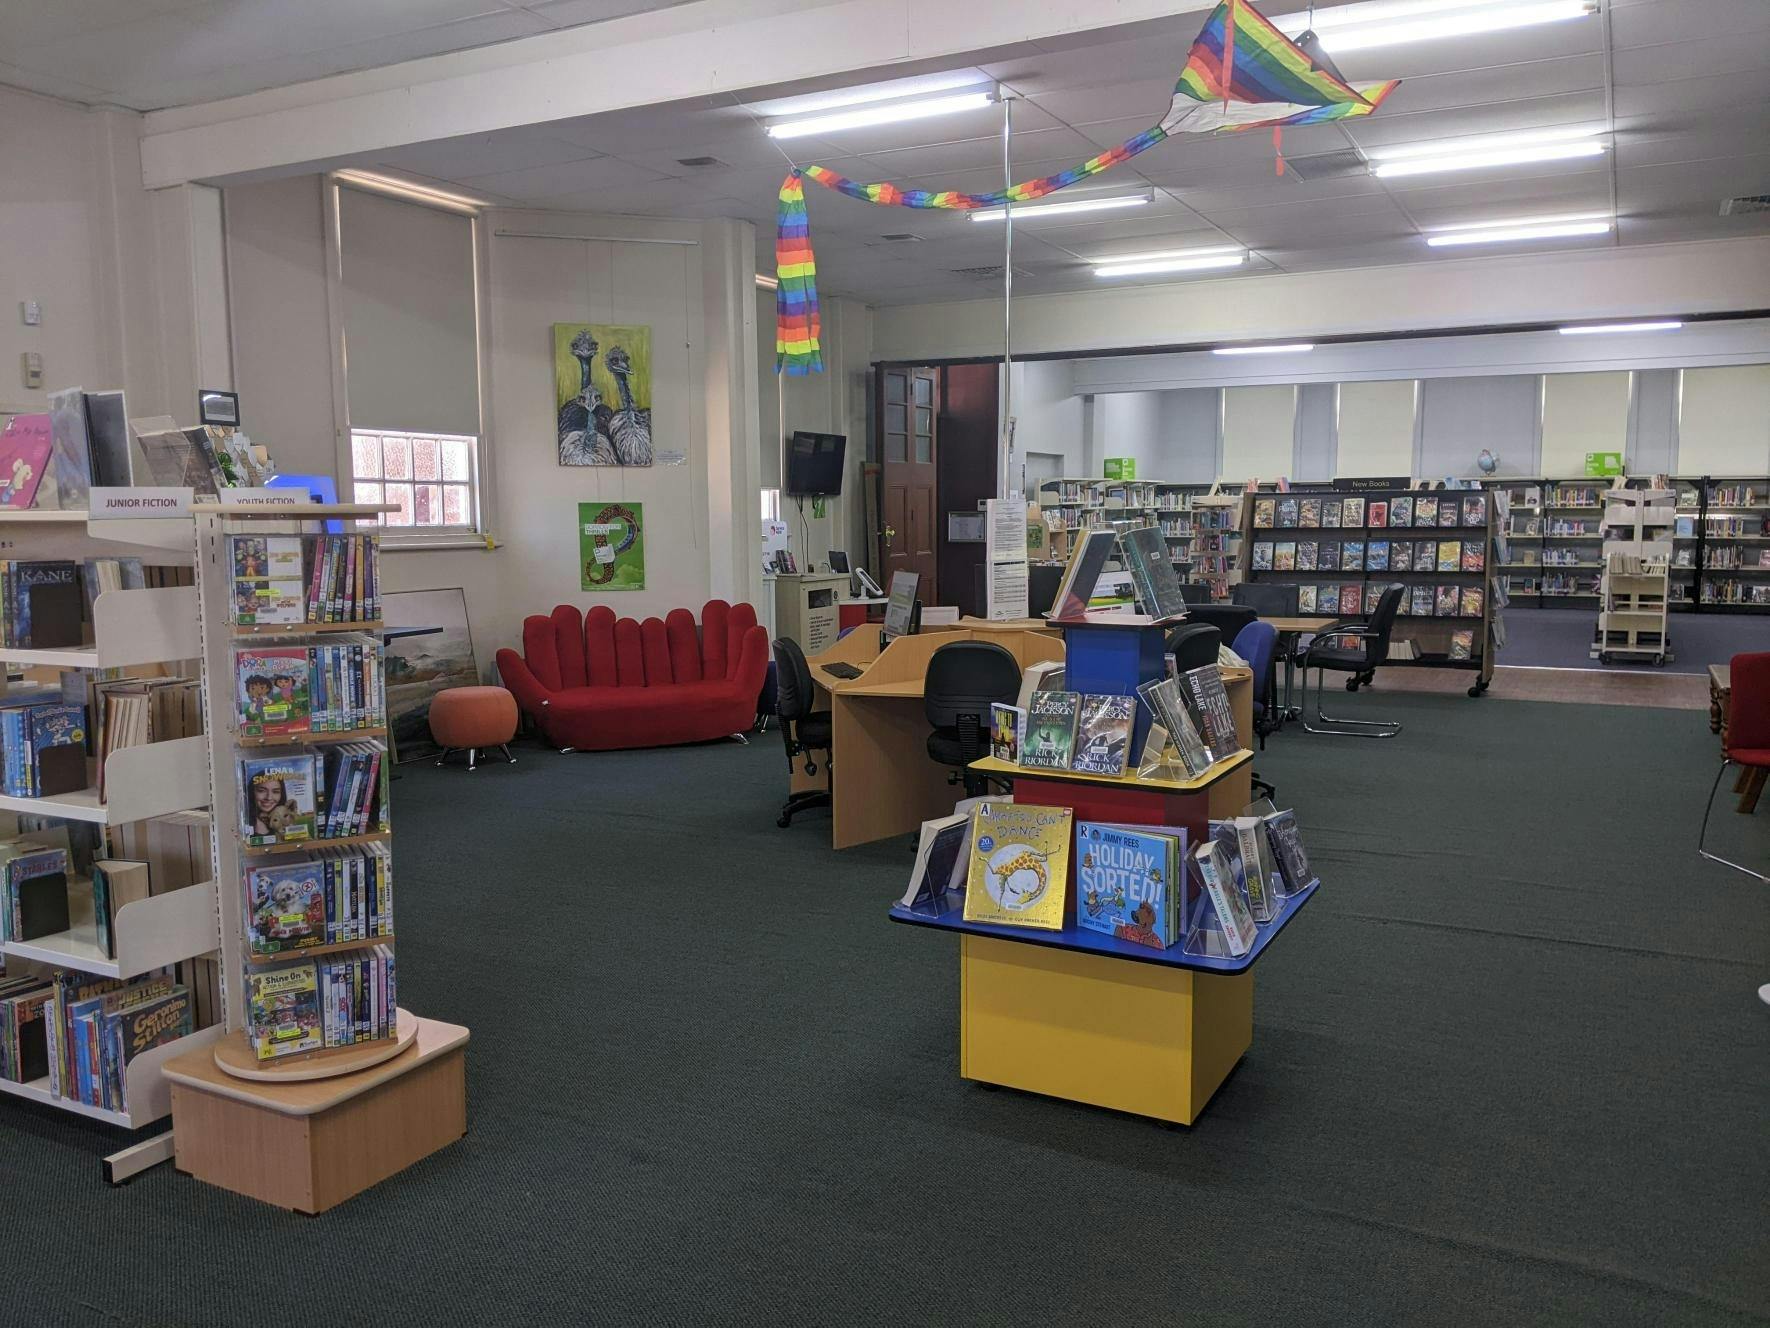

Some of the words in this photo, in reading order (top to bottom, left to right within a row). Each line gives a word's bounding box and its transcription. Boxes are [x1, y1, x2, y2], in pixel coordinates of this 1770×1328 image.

[1352, 480, 1367, 488] New
[1369, 480, 1390, 488] Books
[105, 498, 140, 508] JUNIOR
[142, 498, 177, 508] FICTION
[21, 570, 73, 583] KANE
[1190, 675, 1201, 694] ECHO
[1046, 700, 1069, 708] PERCY
[1195, 693, 1207, 711] LAKE
[1031, 704, 1075, 715] JACKSON
[1035, 748, 1058, 757] RICK
[1086, 752, 1110, 762] RICK
[1025, 756, 1068, 767] RIORDAN
[1075, 760, 1119, 773] RIORDAN
[252, 772, 307, 785] SNOW
[981, 804, 989, 814] A
[1036, 812, 1065, 826] CAN'T
[996, 825, 1043, 840] DANCE
[1080, 825, 1088, 838] R
[1102, 832, 1123, 844] JIMMY
[1123, 837, 1140, 849] REES
[1088, 843, 1155, 877] HOLIDAY
[1080, 866, 1163, 910] SORTED!
[265, 974, 289, 985] Shine
[290, 971, 301, 980] On
[133, 997, 187, 1034] Geronimo
[132, 1011, 180, 1054] Stilton
